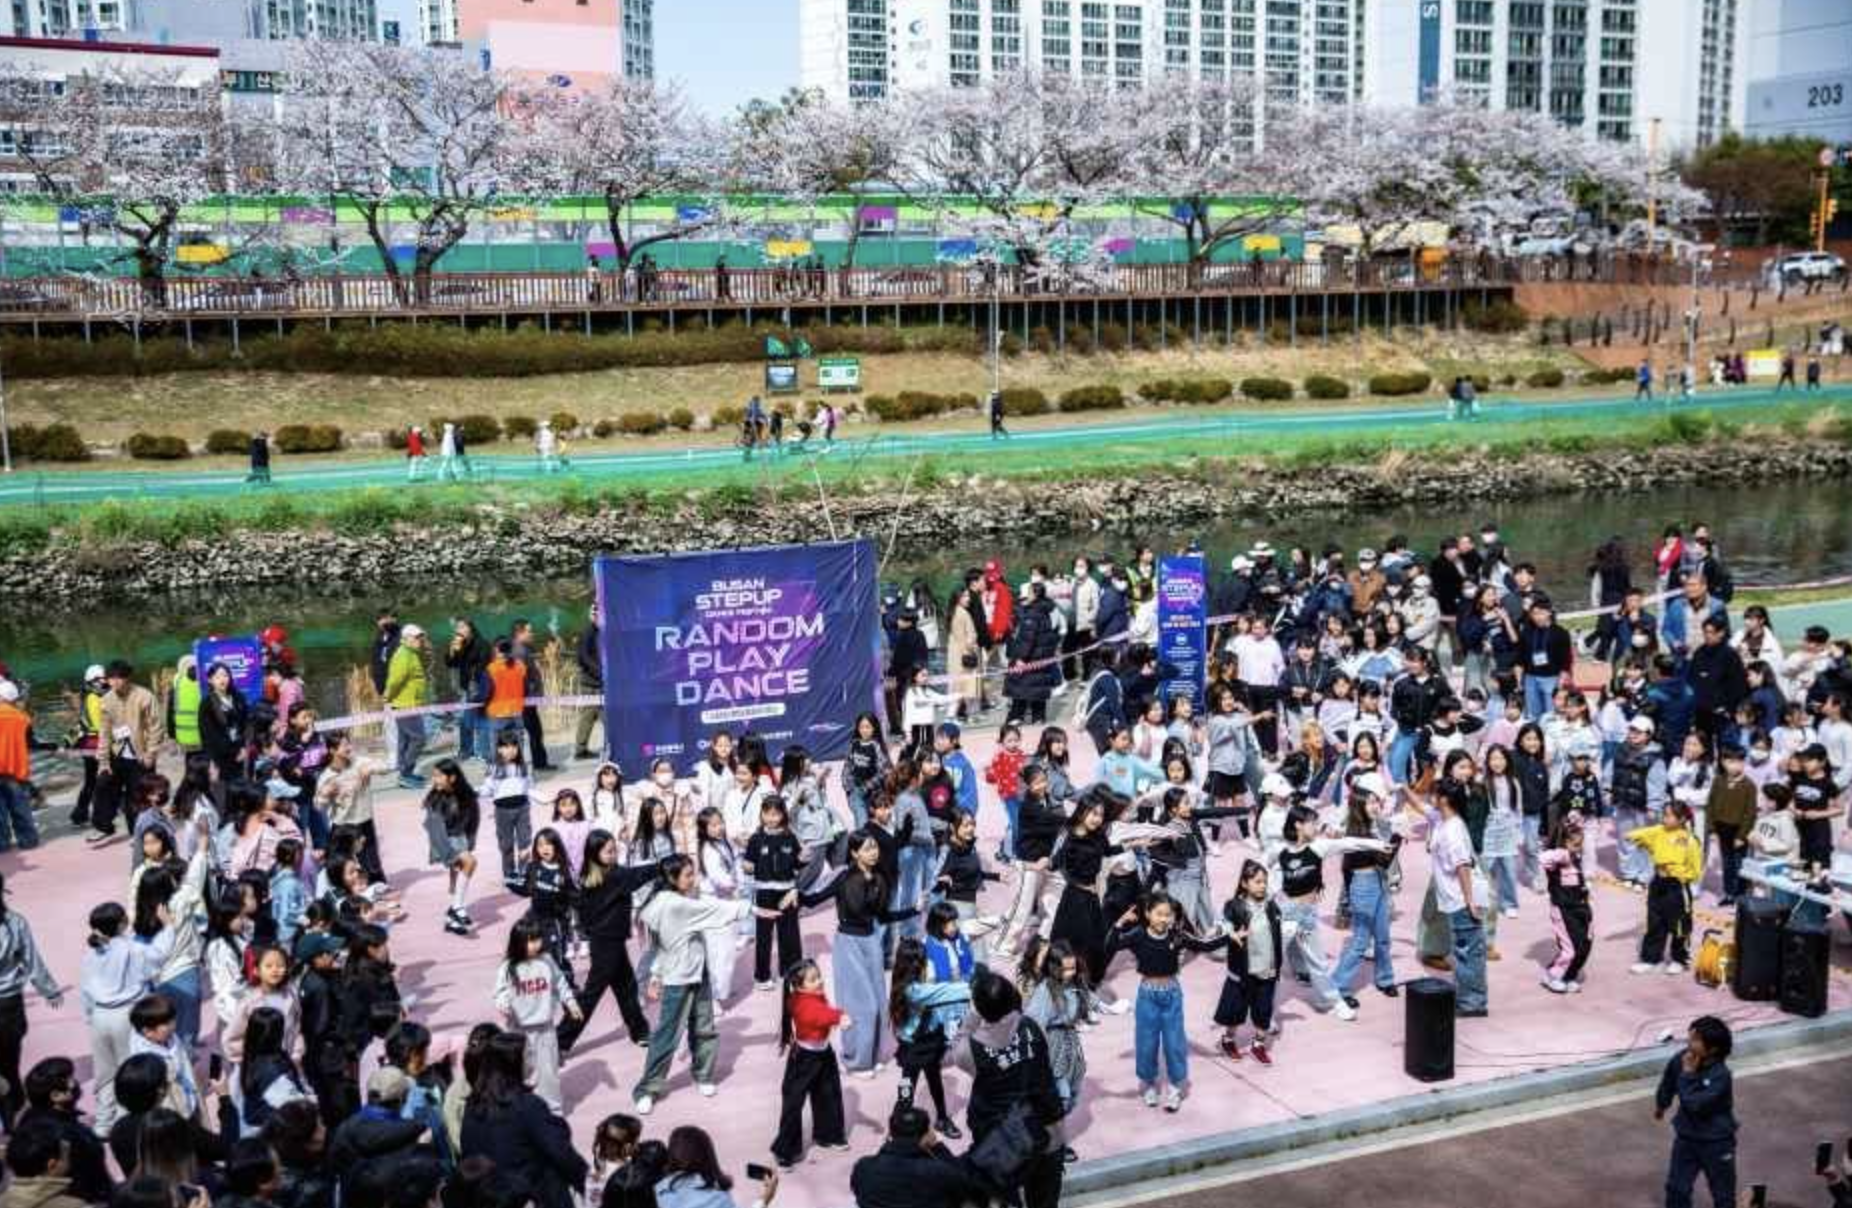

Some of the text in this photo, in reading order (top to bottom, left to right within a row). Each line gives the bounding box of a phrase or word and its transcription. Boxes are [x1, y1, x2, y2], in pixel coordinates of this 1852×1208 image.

[1807, 84, 1843, 108] 203
[695, 588, 783, 610] STEPUP
[711, 579, 765, 592] BUSAN
[655, 612, 825, 651] RANDOM
[687, 643, 791, 677] PLAY
[675, 668, 811, 706] DANCE
